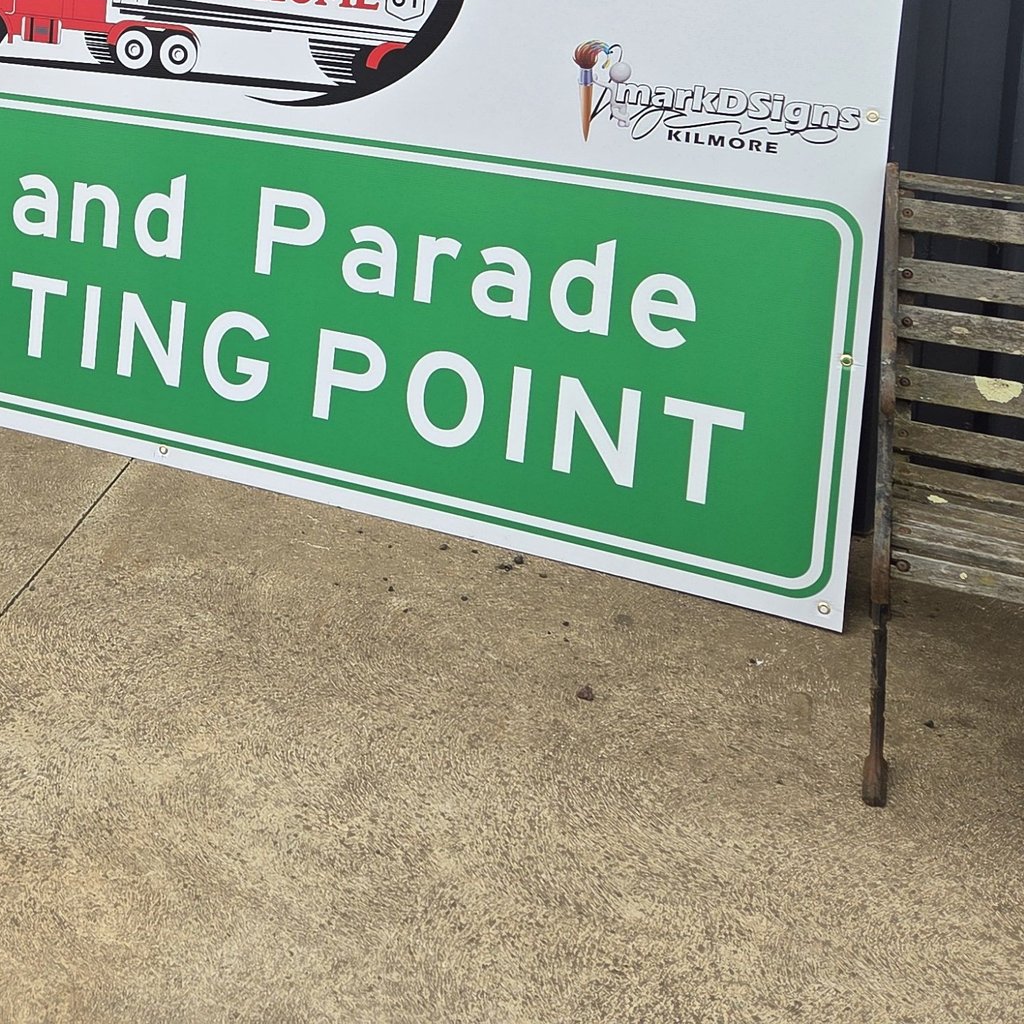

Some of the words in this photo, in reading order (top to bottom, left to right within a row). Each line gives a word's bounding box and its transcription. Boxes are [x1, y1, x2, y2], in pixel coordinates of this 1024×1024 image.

[615, 81, 861, 132] markDSigns
[667, 129, 778, 154] KILMORE
[12, 174, 187, 260] and
[254, 186, 696, 349] Parade
[311, 327, 746, 505] POINT
